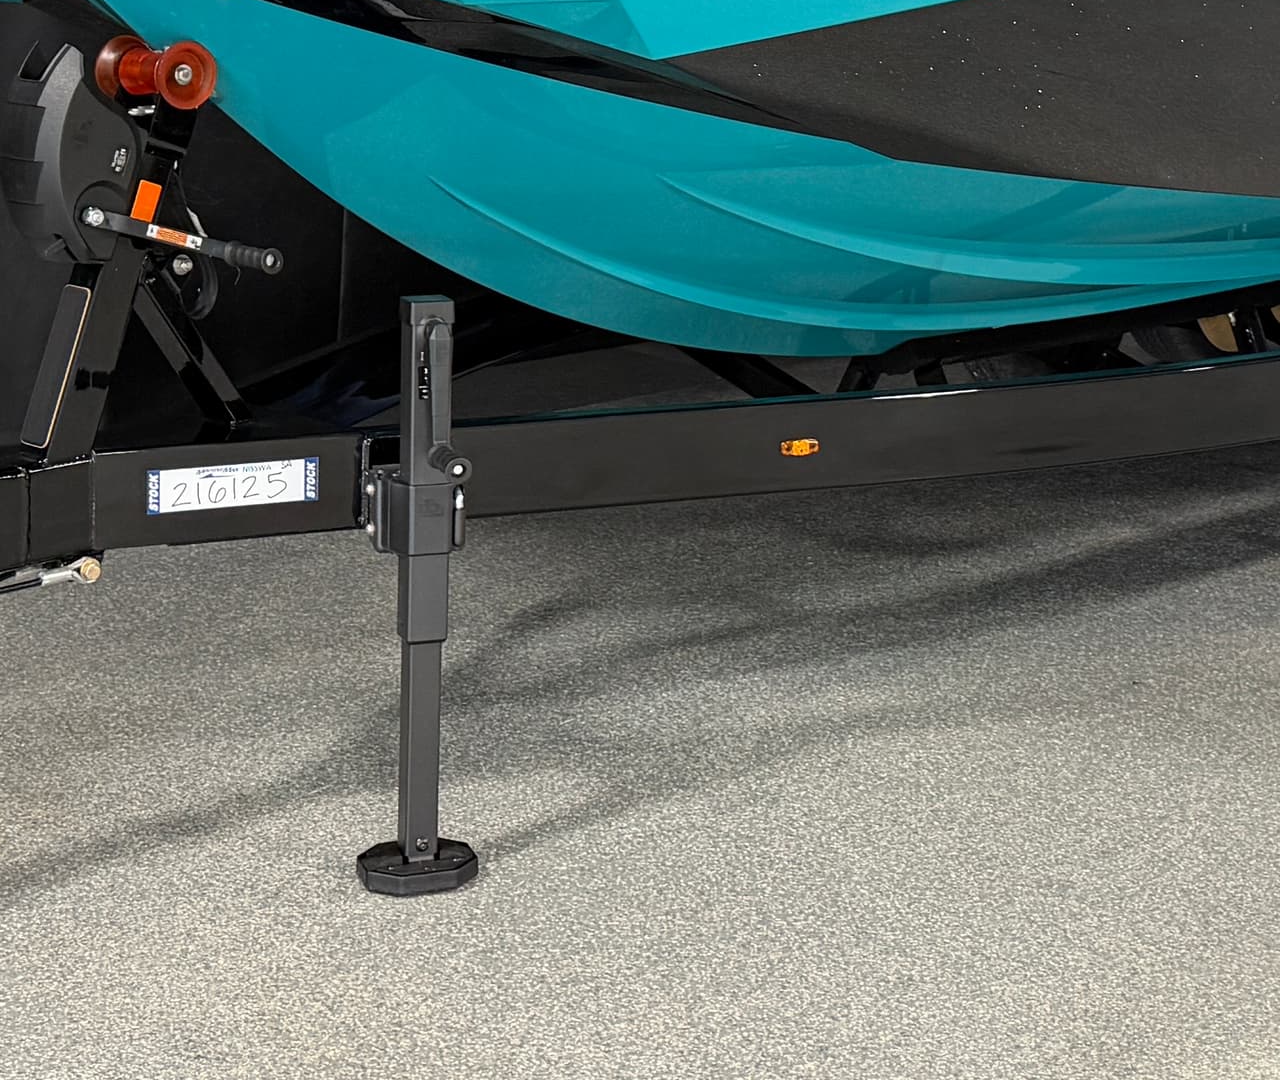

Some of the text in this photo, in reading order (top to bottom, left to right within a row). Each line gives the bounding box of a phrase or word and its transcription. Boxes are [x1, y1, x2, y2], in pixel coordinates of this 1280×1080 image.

[148, 473, 160, 512] STOCK
[171, 471, 288, 508] 216125
[305, 461, 317, 499] STOCK
